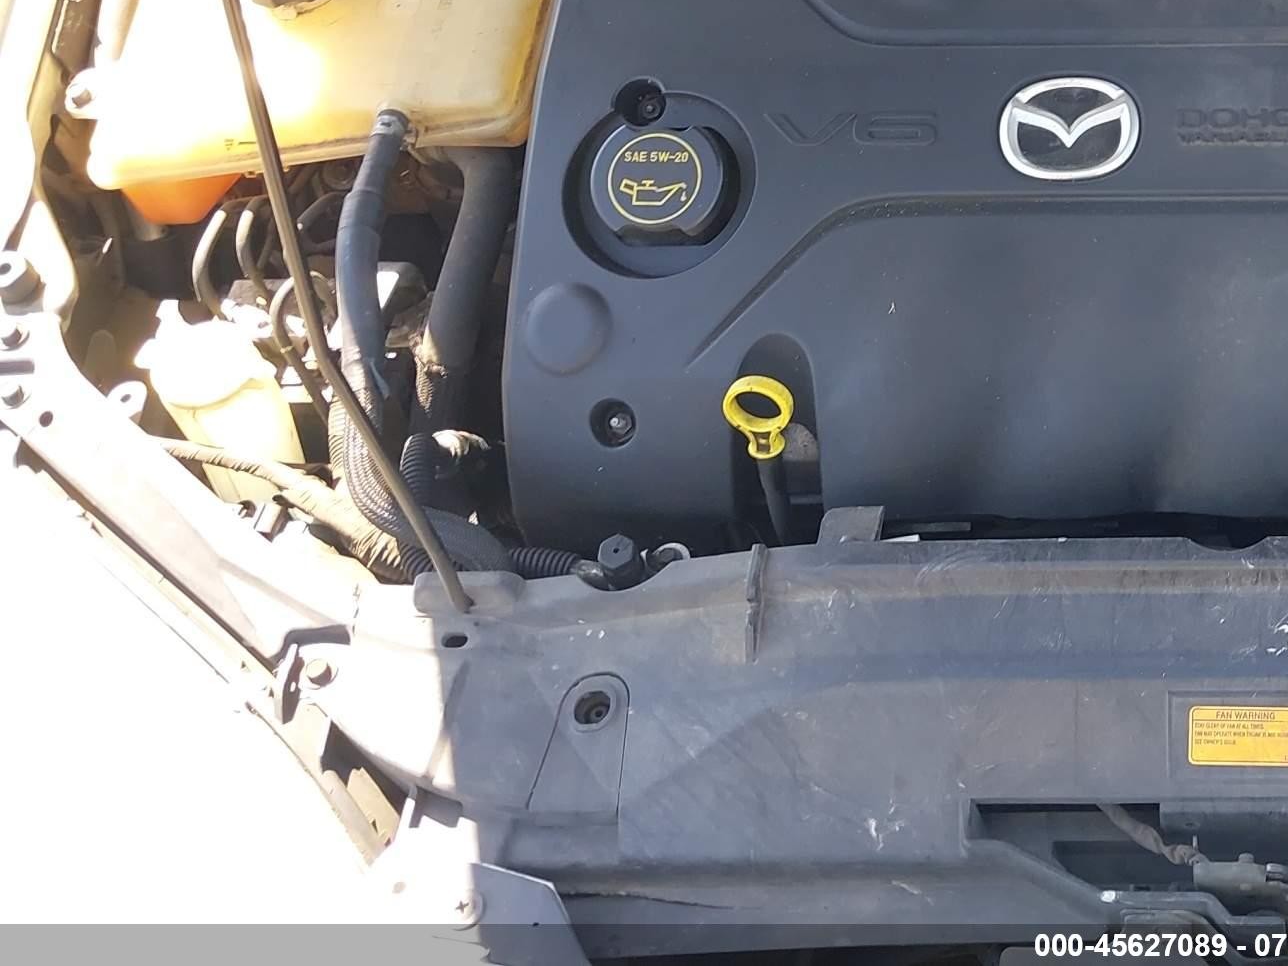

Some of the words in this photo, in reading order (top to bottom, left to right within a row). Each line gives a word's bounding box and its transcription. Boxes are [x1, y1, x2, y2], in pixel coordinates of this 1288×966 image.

[762, 113, 938, 146] V6
[624, 151, 649, 162] SAE
[649, 151, 689, 162] 5W-20
[1235, 712, 1276, 720] WARNING
